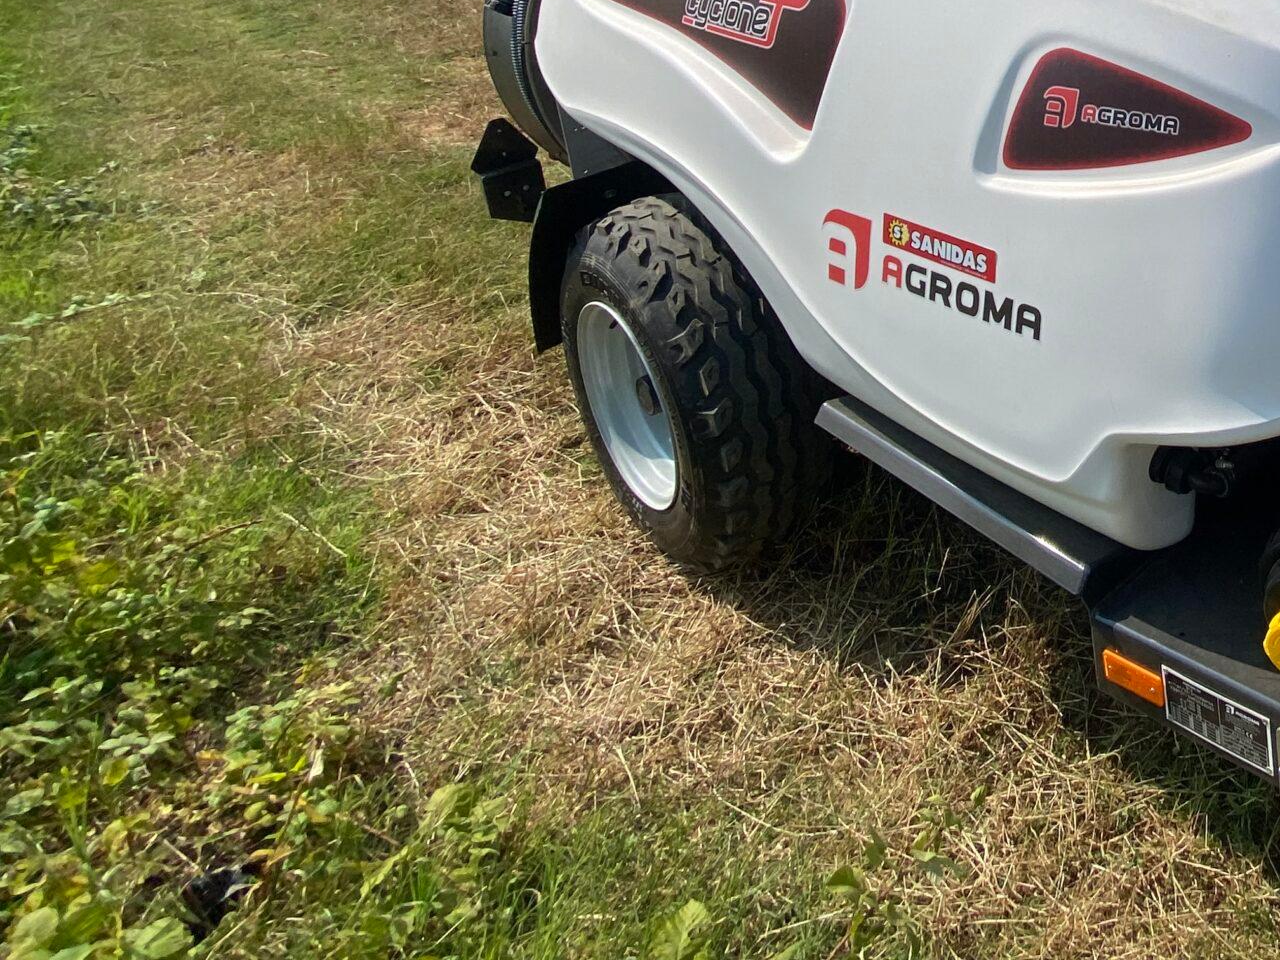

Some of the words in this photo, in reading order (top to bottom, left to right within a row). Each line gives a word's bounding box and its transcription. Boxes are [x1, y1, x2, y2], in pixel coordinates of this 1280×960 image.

[1081, 104, 1180, 135] AGROMA
[910, 231, 988, 273] SANIDAS
[882, 254, 1041, 341] AGROMA
